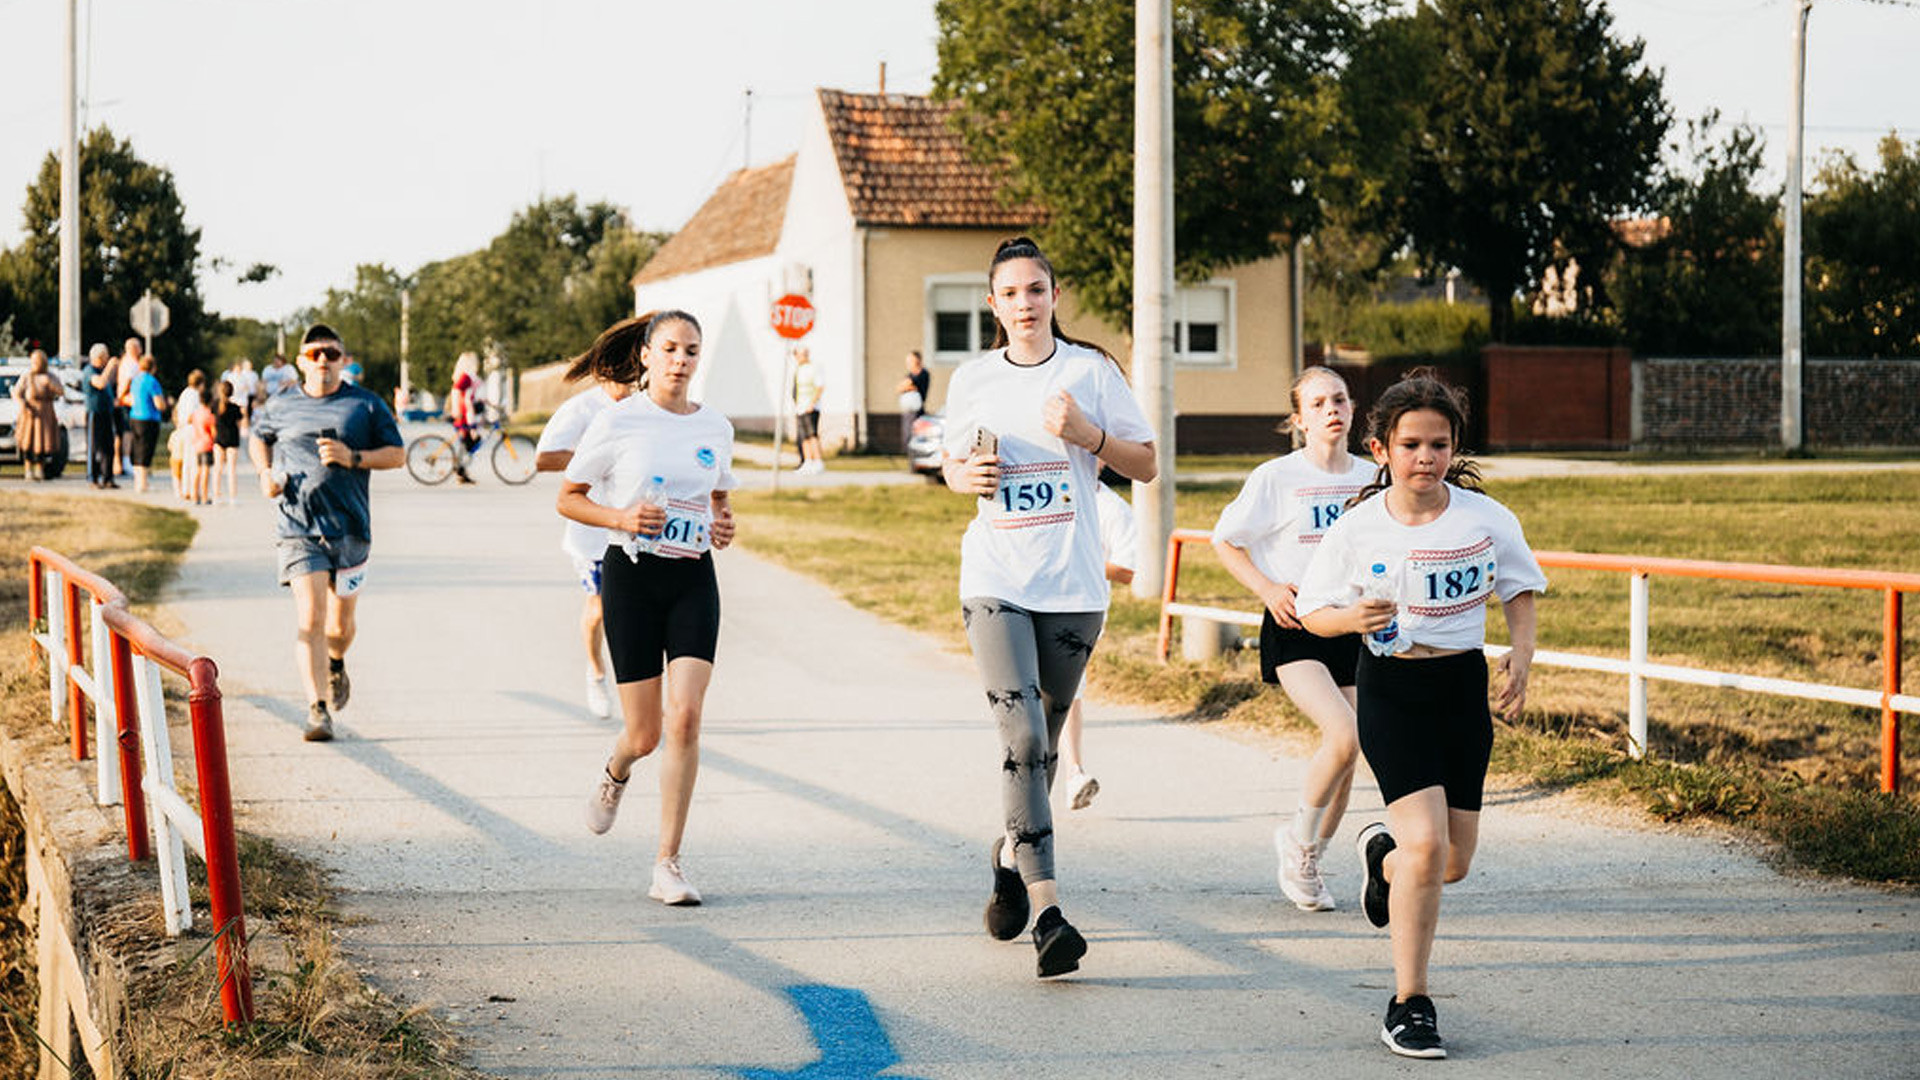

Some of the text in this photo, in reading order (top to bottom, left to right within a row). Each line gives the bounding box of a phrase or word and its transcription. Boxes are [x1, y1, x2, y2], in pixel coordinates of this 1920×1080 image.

[769, 304, 815, 328] STOP
[1000, 481, 1053, 512] 159
[1312, 503, 1344, 529] 18
[1424, 565, 1480, 600] 182
